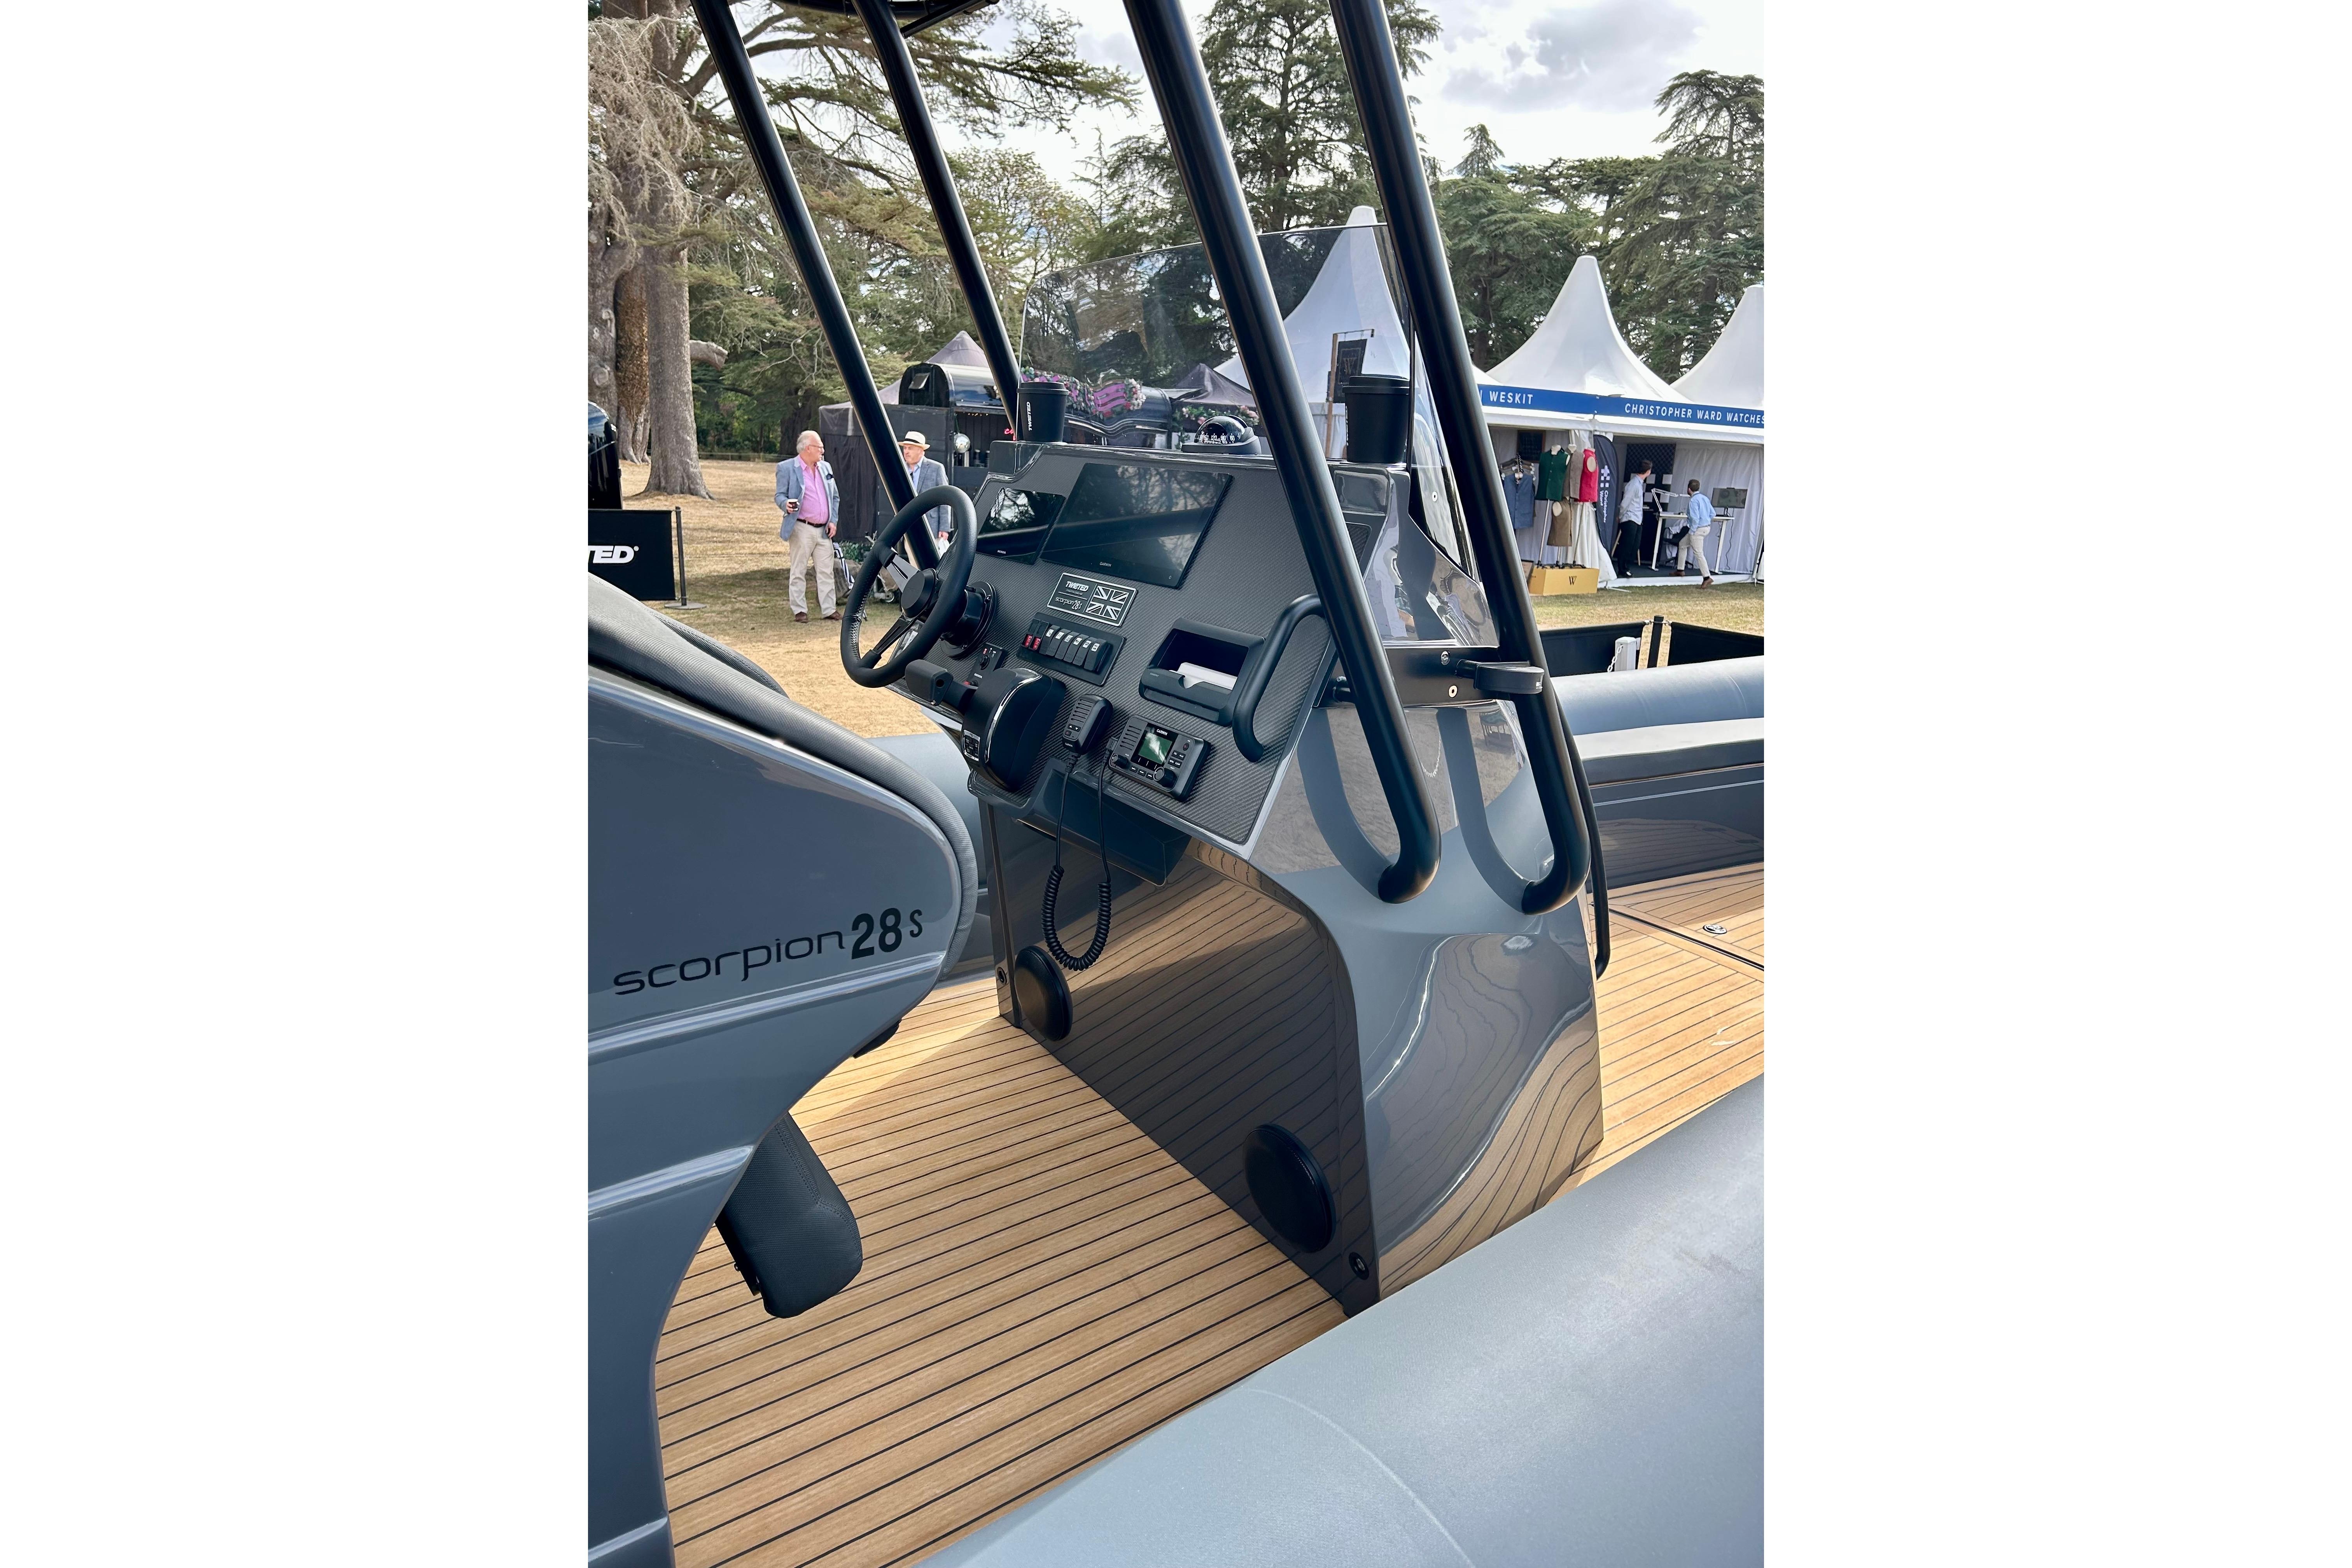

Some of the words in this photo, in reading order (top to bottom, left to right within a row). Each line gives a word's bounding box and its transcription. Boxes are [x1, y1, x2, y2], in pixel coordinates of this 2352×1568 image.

[1489, 390, 1533, 404] WESKIT
[1625, 403, 1692, 418] CHRISTOPHER
[1697, 410, 1722, 420] WARD
[1066, 581, 1089, 592] TWISTED
[1569, 575, 1577, 586] W
[1055, 597, 1074, 606] scorpion
[614, 931, 846, 995] scorpion
